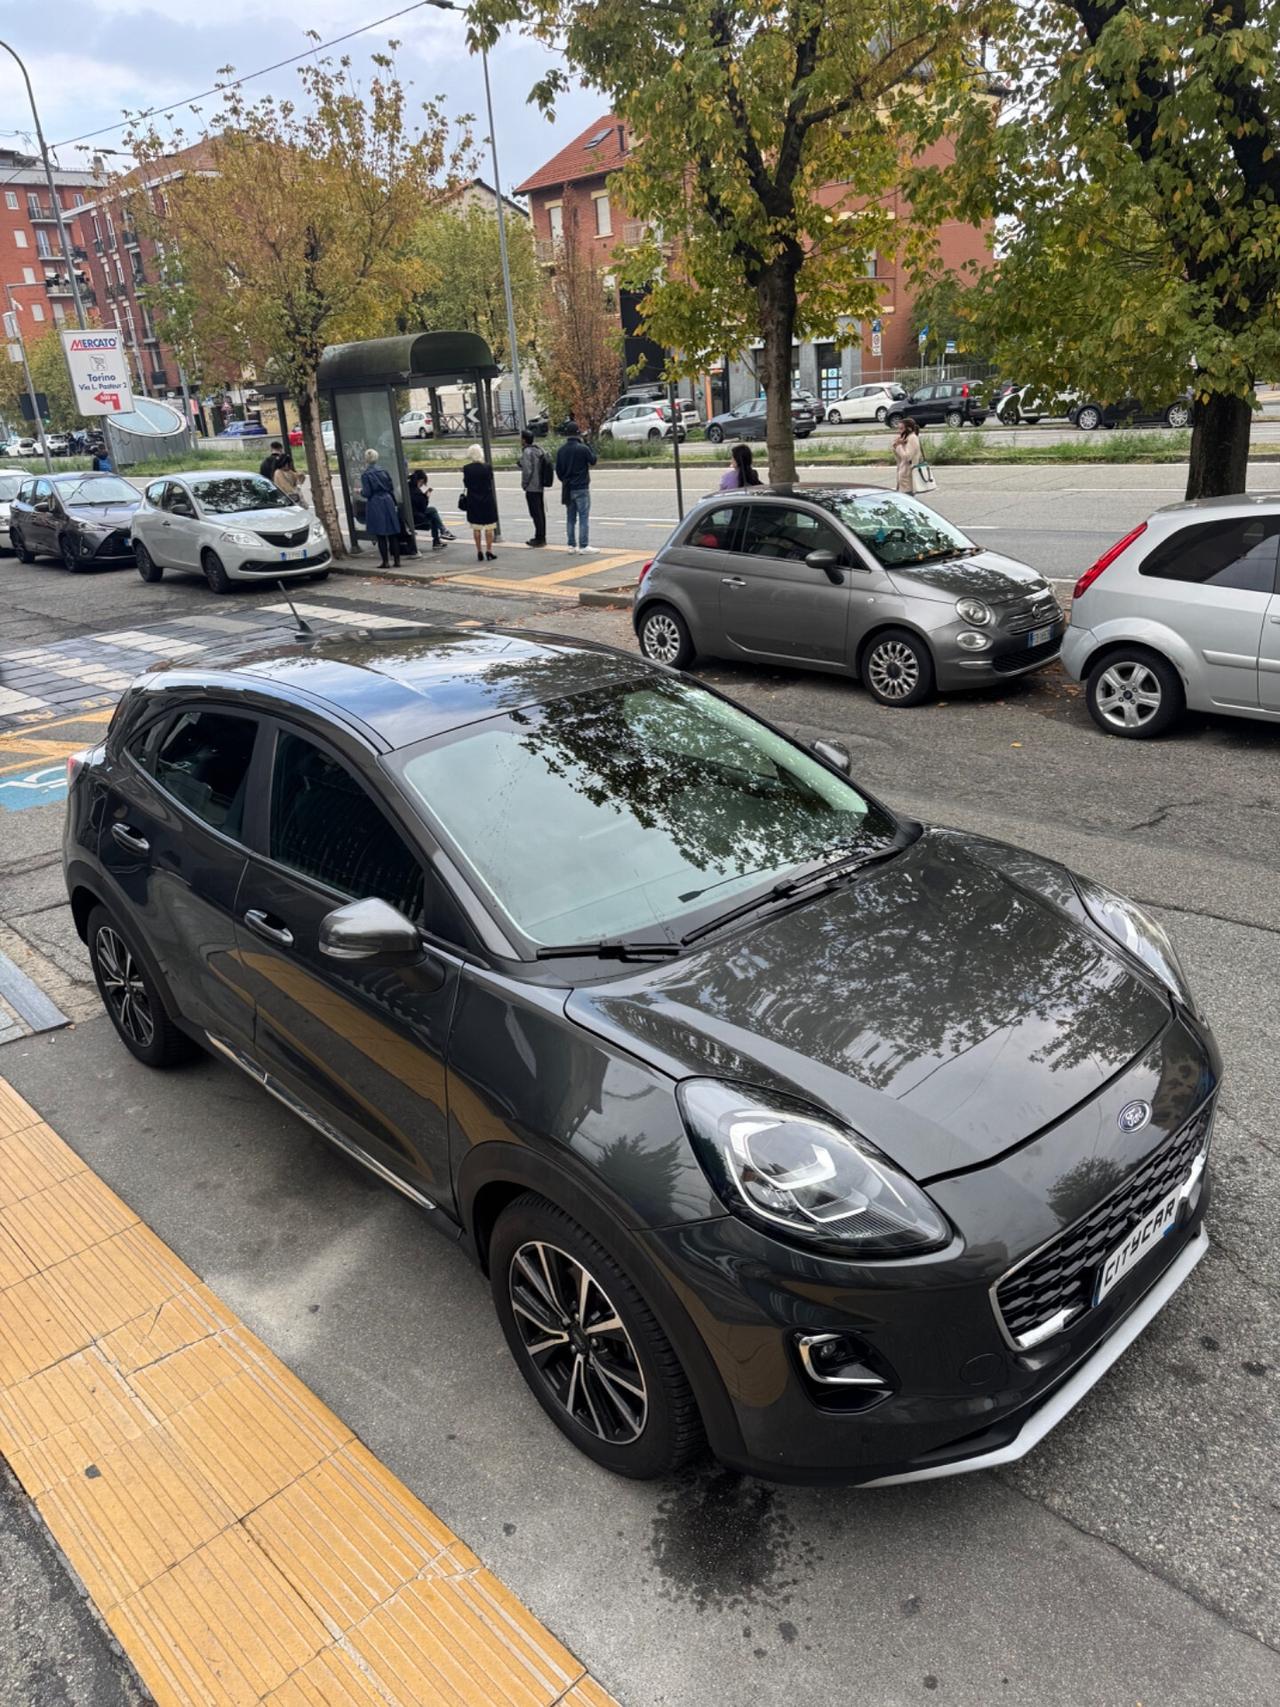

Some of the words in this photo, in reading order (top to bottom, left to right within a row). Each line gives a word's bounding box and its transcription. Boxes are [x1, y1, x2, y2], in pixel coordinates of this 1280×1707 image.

[71, 338, 117, 351] MERCATO
[87, 372, 116, 382] Torino
[79, 383, 91, 391] Via
[1104, 1198, 1175, 1286] CITYCAR
